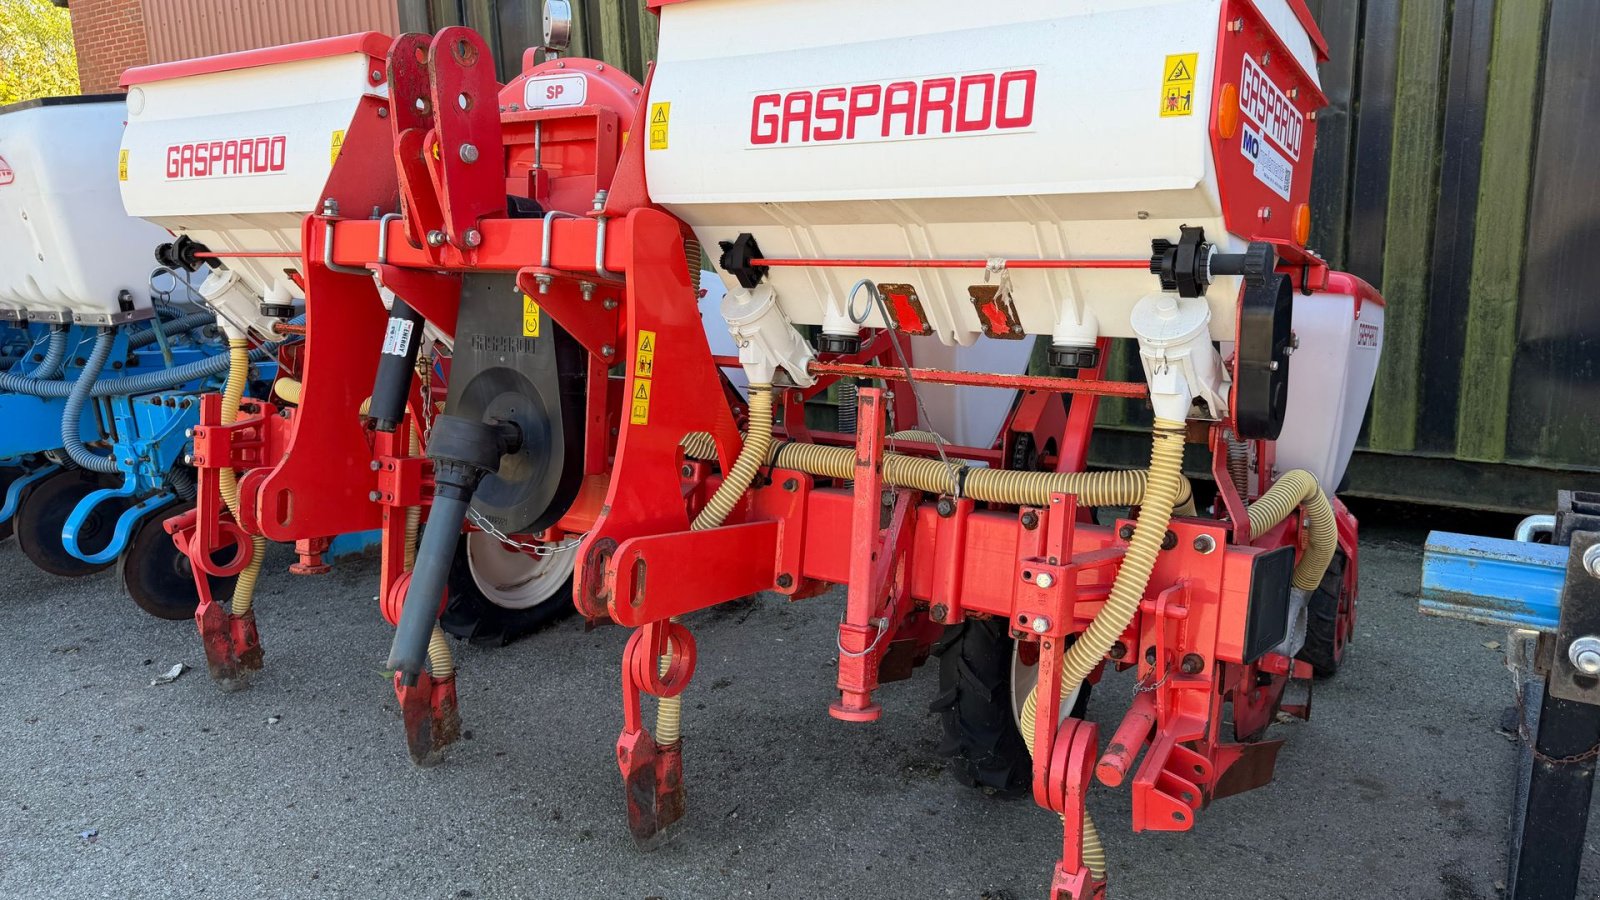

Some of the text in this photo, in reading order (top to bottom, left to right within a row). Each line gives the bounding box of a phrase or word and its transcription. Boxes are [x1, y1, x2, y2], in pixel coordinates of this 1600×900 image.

[546, 84, 564, 100] SP
[750, 69, 1038, 145] GASPARDO
[1240, 58, 1302, 158] GASPARDO
[166, 135, 287, 178] GASPARDO
[471, 334, 536, 354] GASPARDO
[1358, 322, 1379, 347] GASPARDO
